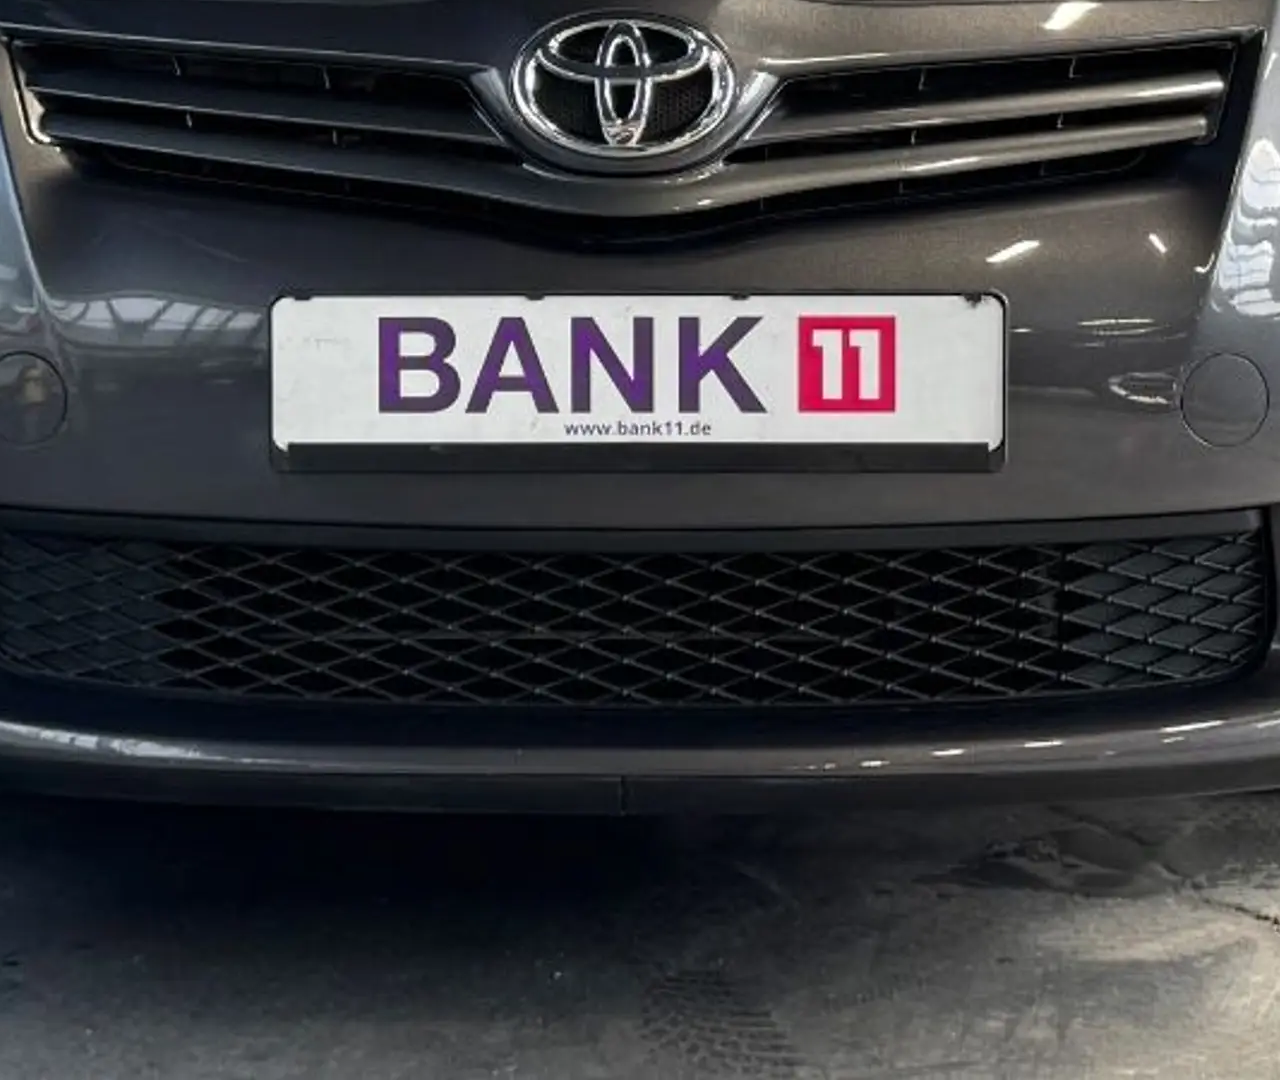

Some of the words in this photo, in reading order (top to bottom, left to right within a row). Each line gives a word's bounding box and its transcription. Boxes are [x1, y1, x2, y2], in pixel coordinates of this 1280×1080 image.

[378, 316, 768, 414] BANK
[811, 328, 882, 401] 11
[564, 420, 712, 436] www.bank11.de
